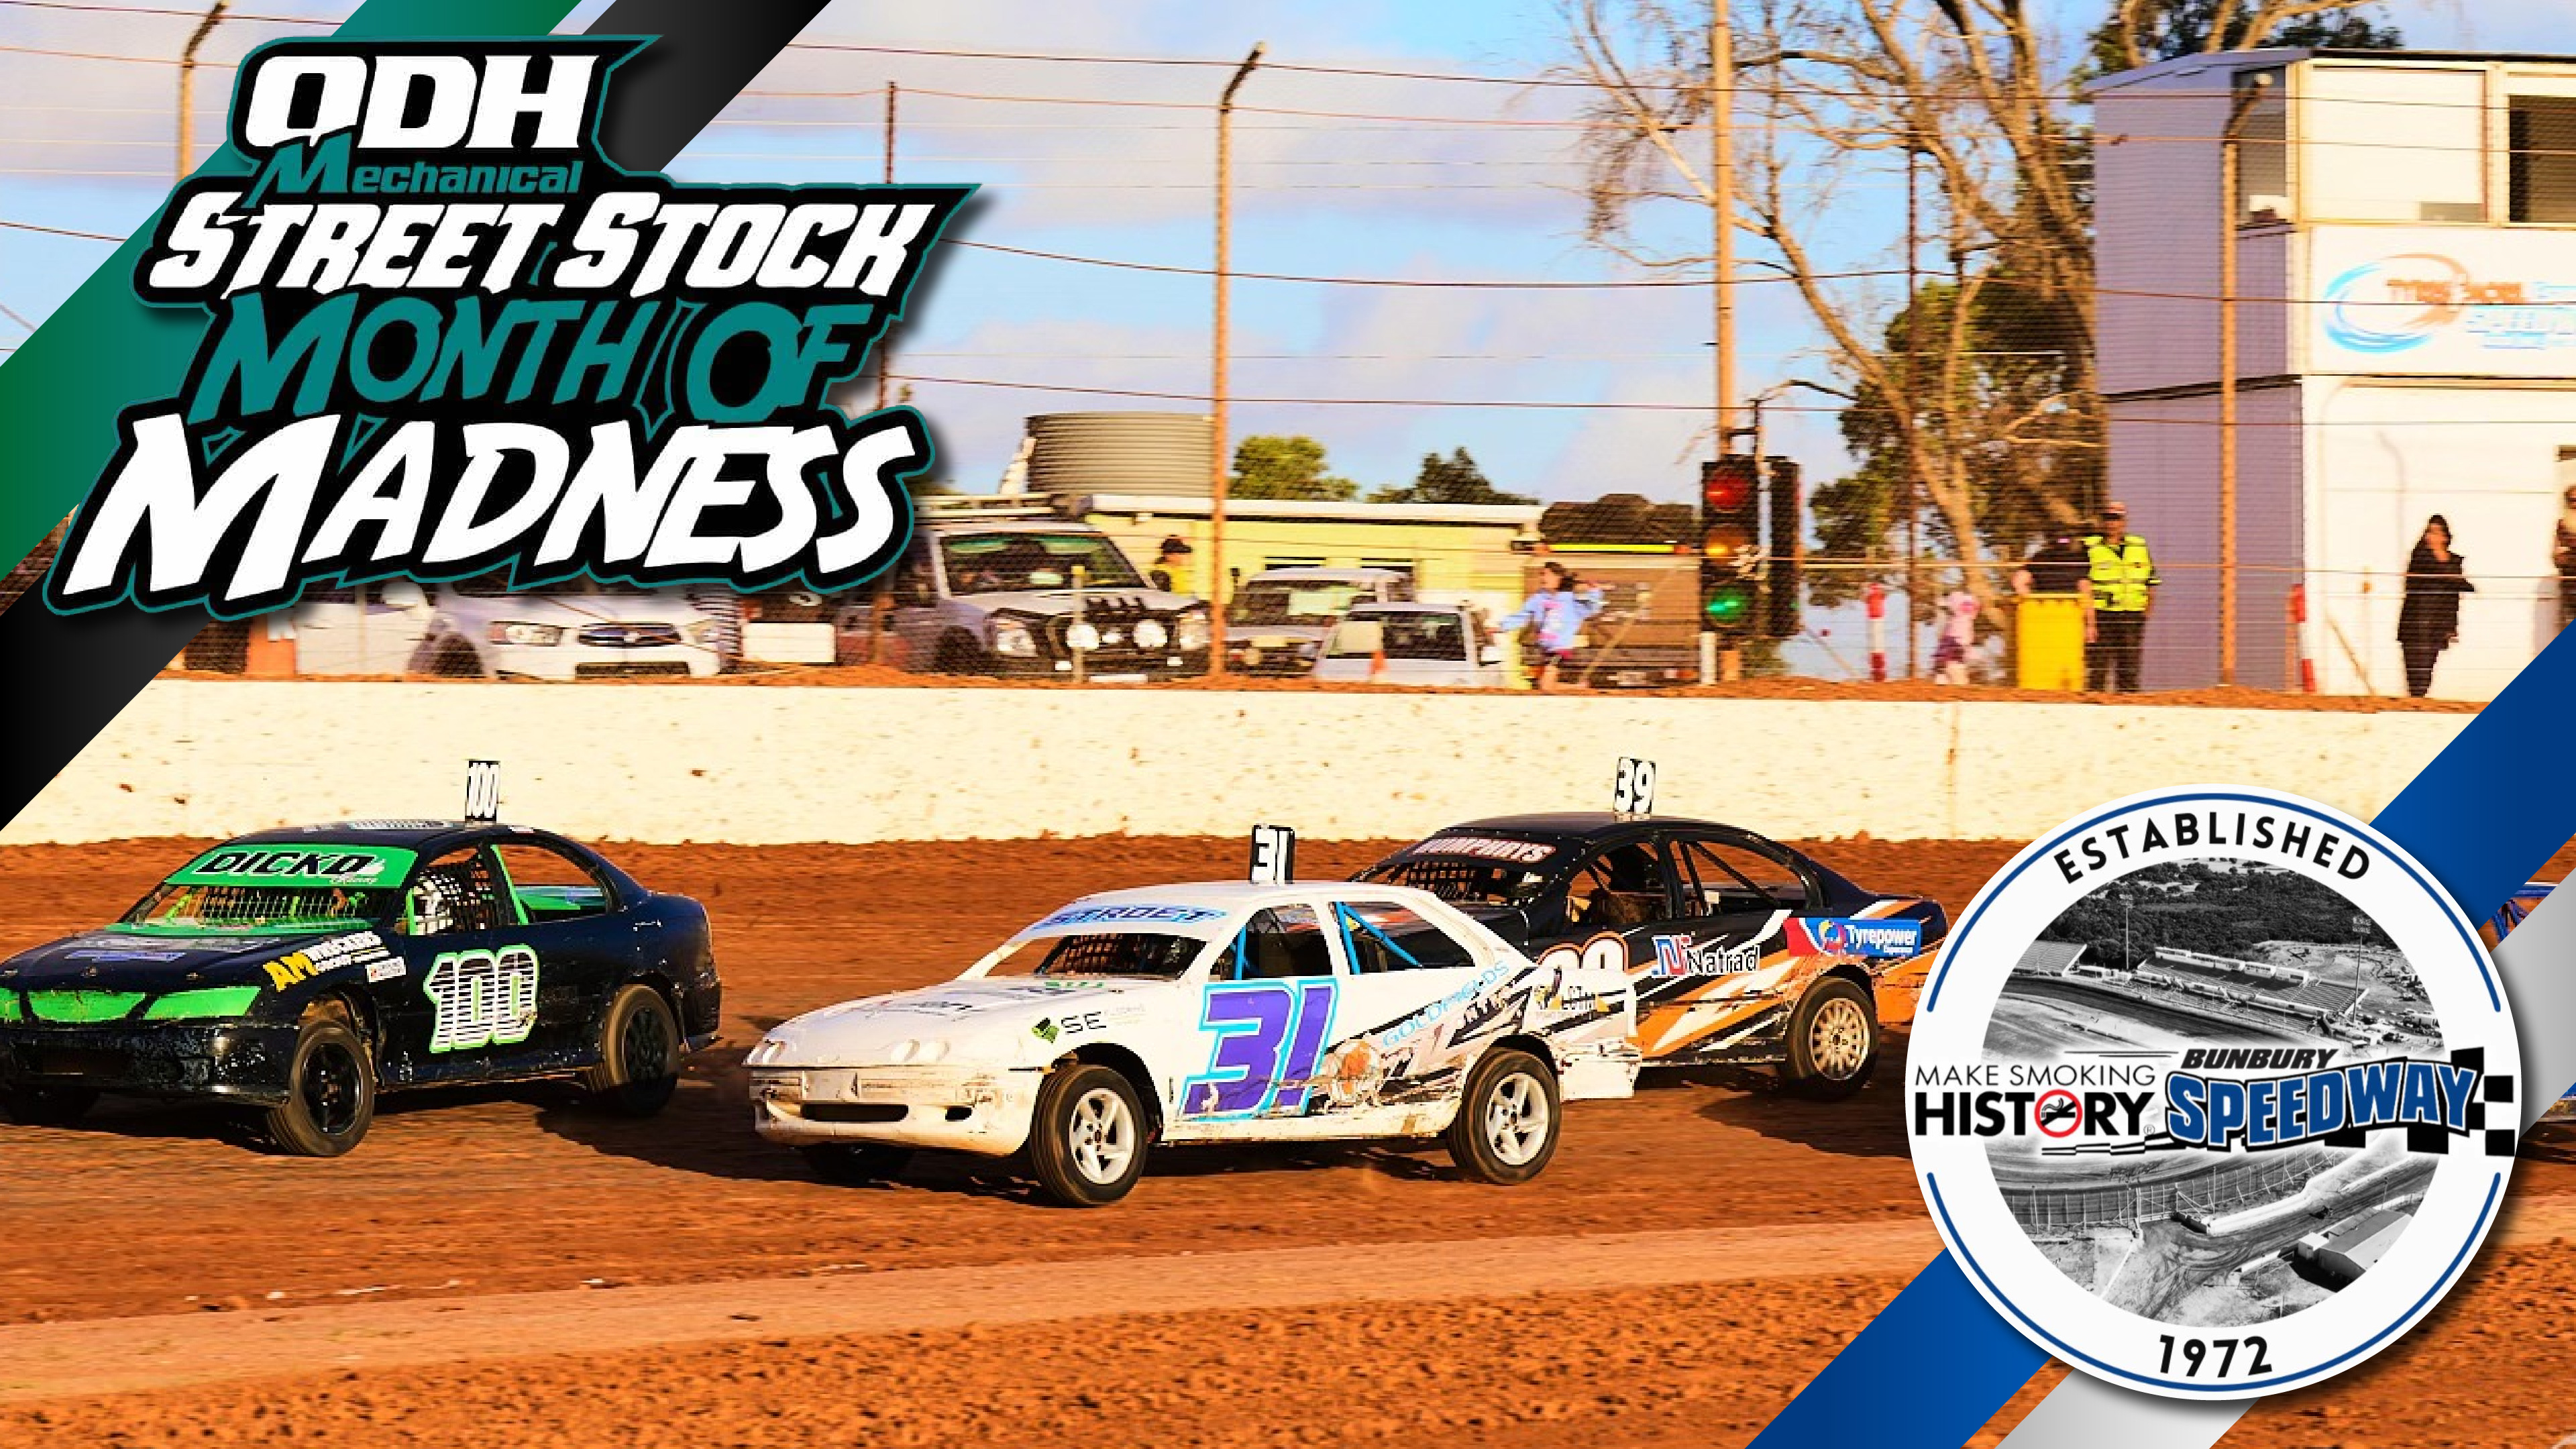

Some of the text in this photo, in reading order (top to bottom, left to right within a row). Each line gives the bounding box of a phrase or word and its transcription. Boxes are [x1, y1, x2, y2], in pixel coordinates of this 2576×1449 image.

[1614, 757, 1653, 814] 39
[1252, 827, 1287, 884] 31
[1686, 945, 1760, 973] Natrad
[1845, 924, 1917, 950] Tyrepower
[262, 952, 320, 993] AM
[423, 943, 539, 1053] 100
[1061, 1012, 1107, 1034] SE
[1179, 977, 1338, 1122] 31
